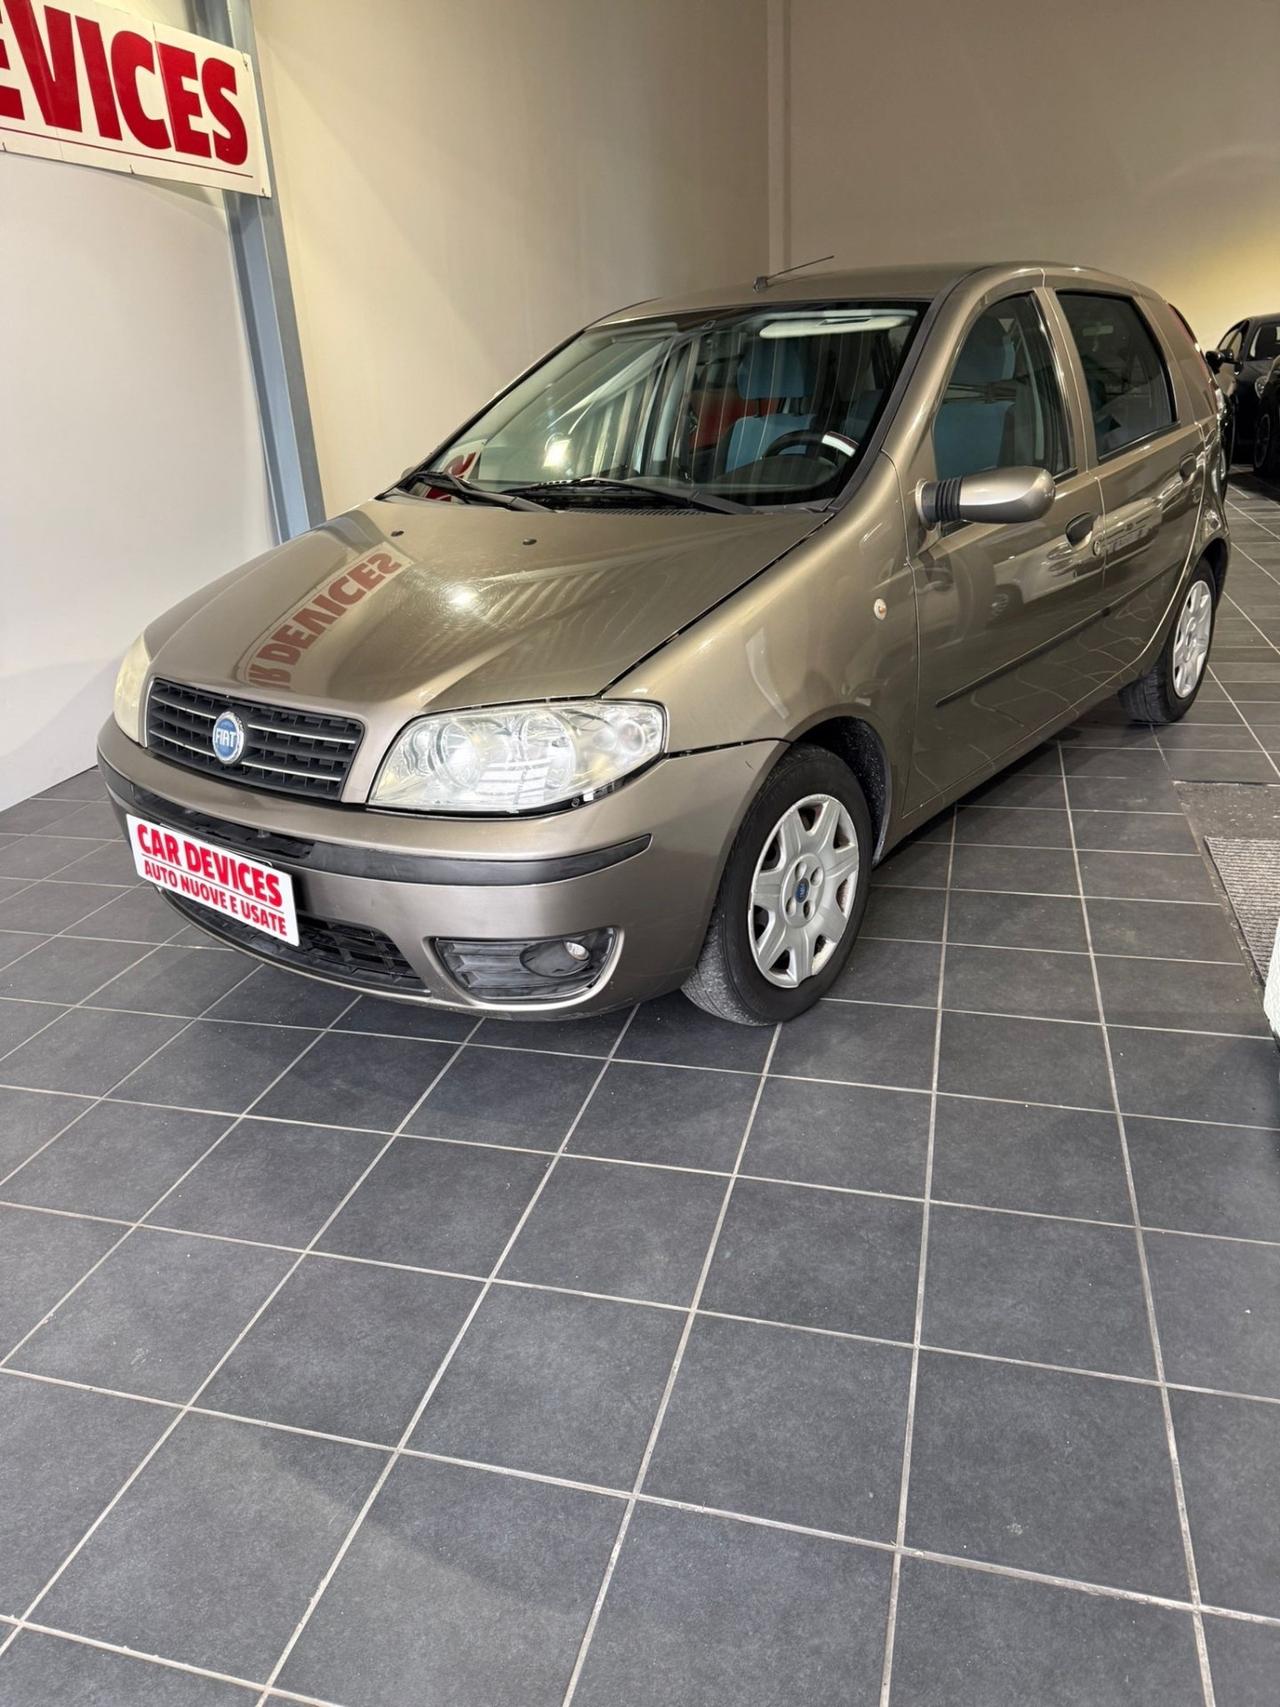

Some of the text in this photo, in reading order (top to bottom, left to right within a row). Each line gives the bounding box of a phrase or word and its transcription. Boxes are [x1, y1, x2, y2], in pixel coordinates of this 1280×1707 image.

[216, 728, 236, 747] FIAT
[137, 824, 283, 907] CAR DEVICES
[144, 861, 287, 936] AUTO NUOVE E USATE
